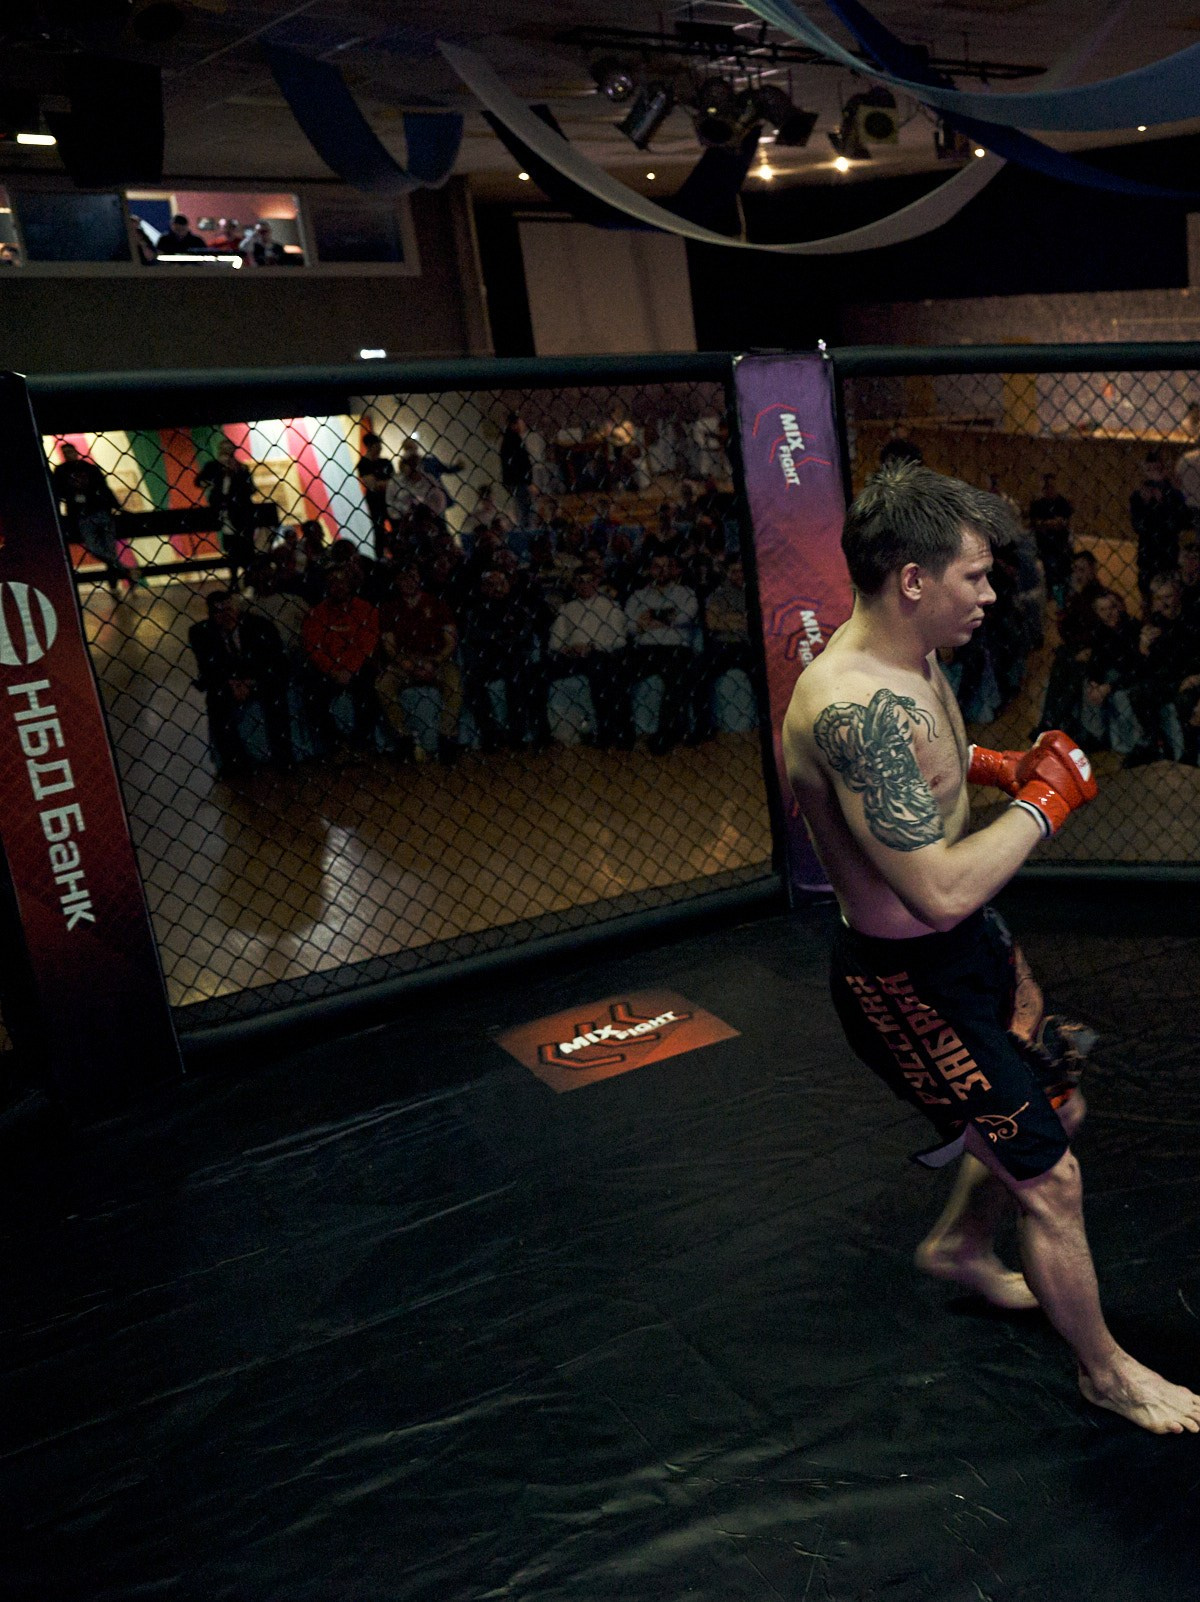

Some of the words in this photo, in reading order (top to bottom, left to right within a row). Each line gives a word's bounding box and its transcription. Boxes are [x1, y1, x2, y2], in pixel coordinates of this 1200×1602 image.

[780, 413, 805, 451] MIX
[779, 445, 800, 486] FIGHT
[800, 610, 823, 645] MIX
[798, 639, 815, 670] FIG
[7, 679, 76, 800] НБД
[39, 802, 97, 931] Банк
[559, 1024, 621, 1054] MIX
[615, 1010, 678, 1040] FIGHT
